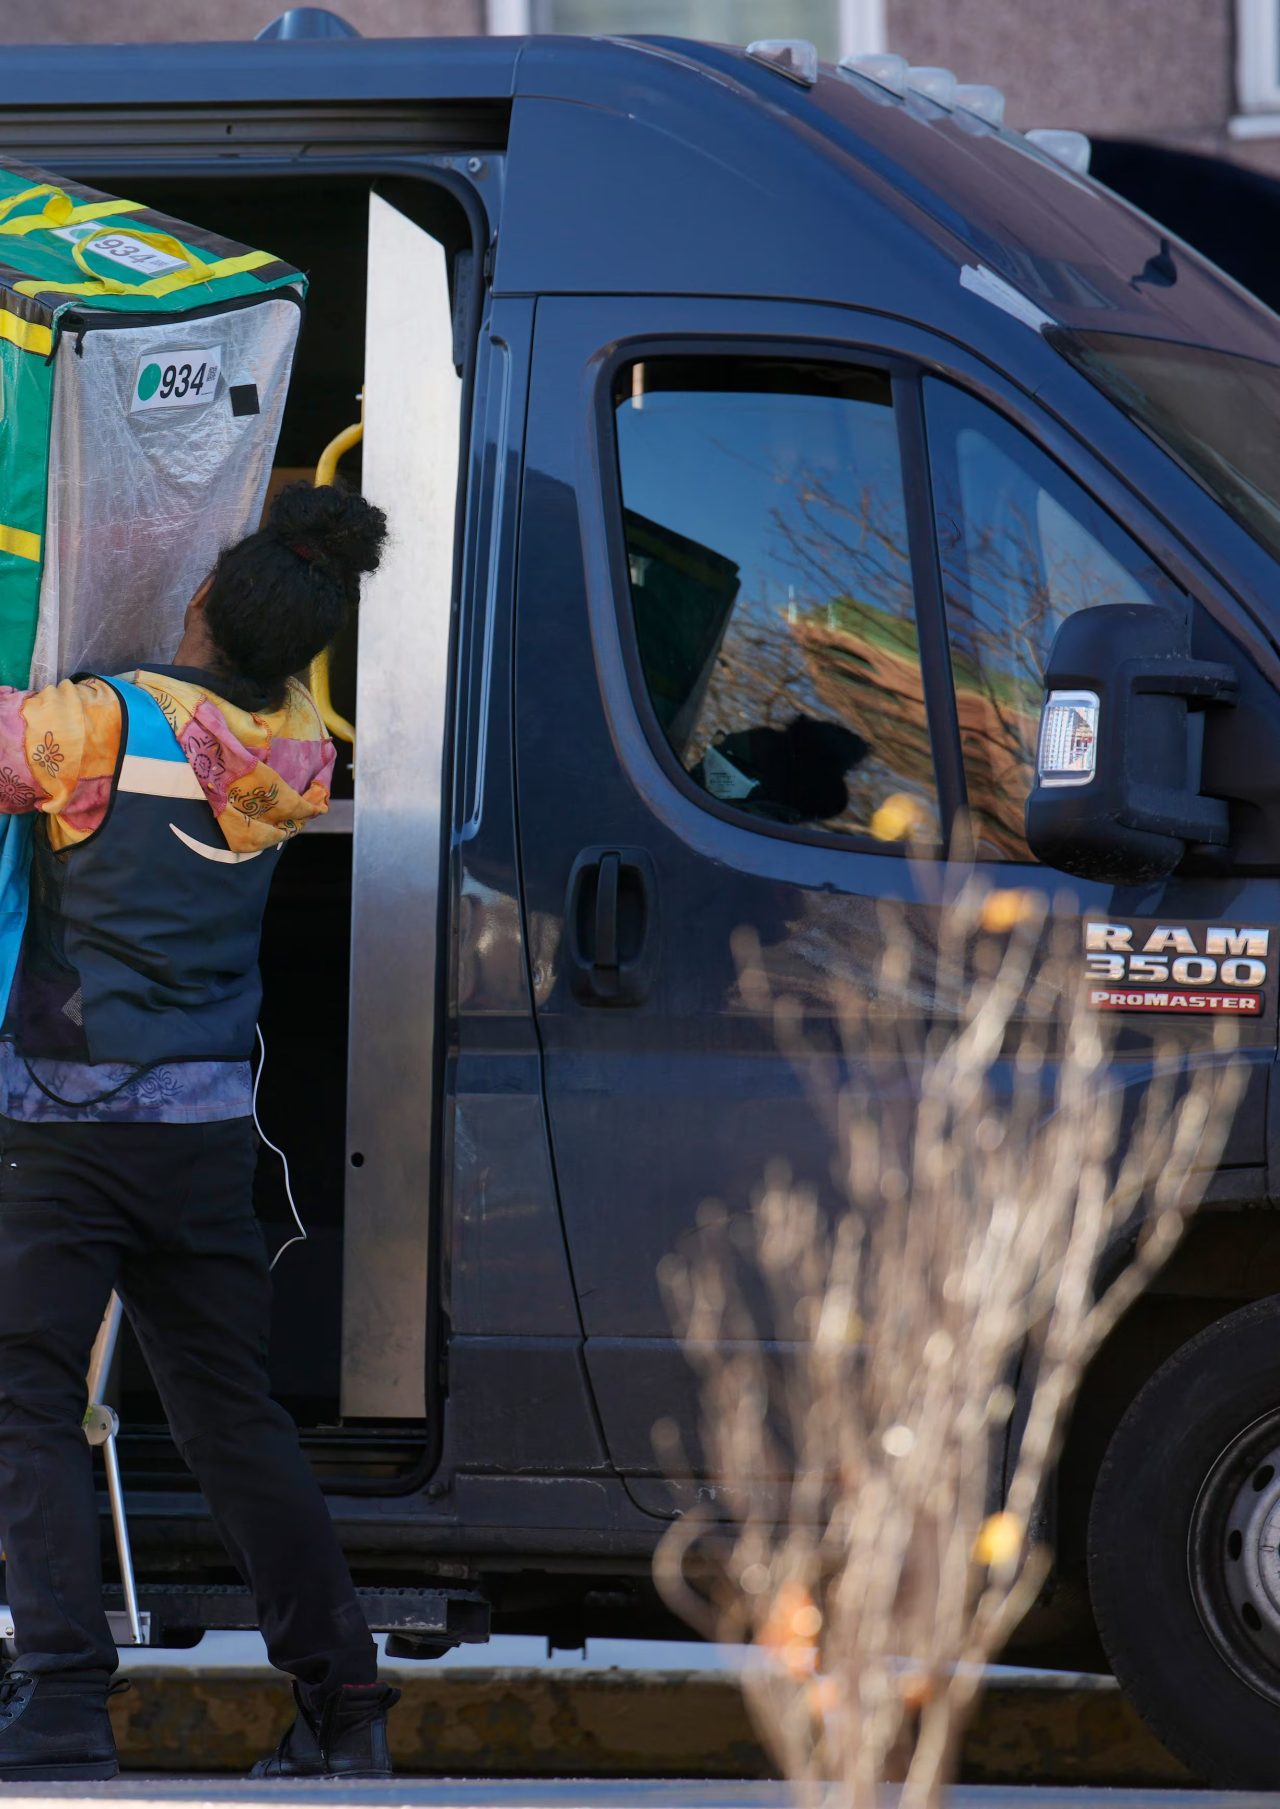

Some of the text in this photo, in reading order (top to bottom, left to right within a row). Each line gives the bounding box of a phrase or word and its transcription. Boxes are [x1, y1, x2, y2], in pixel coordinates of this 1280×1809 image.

[94, 239, 157, 263] 934
[160, 362, 207, 399] 934
[1086, 922, 1269, 956] RAM
[1084, 953, 1267, 987] 3500
